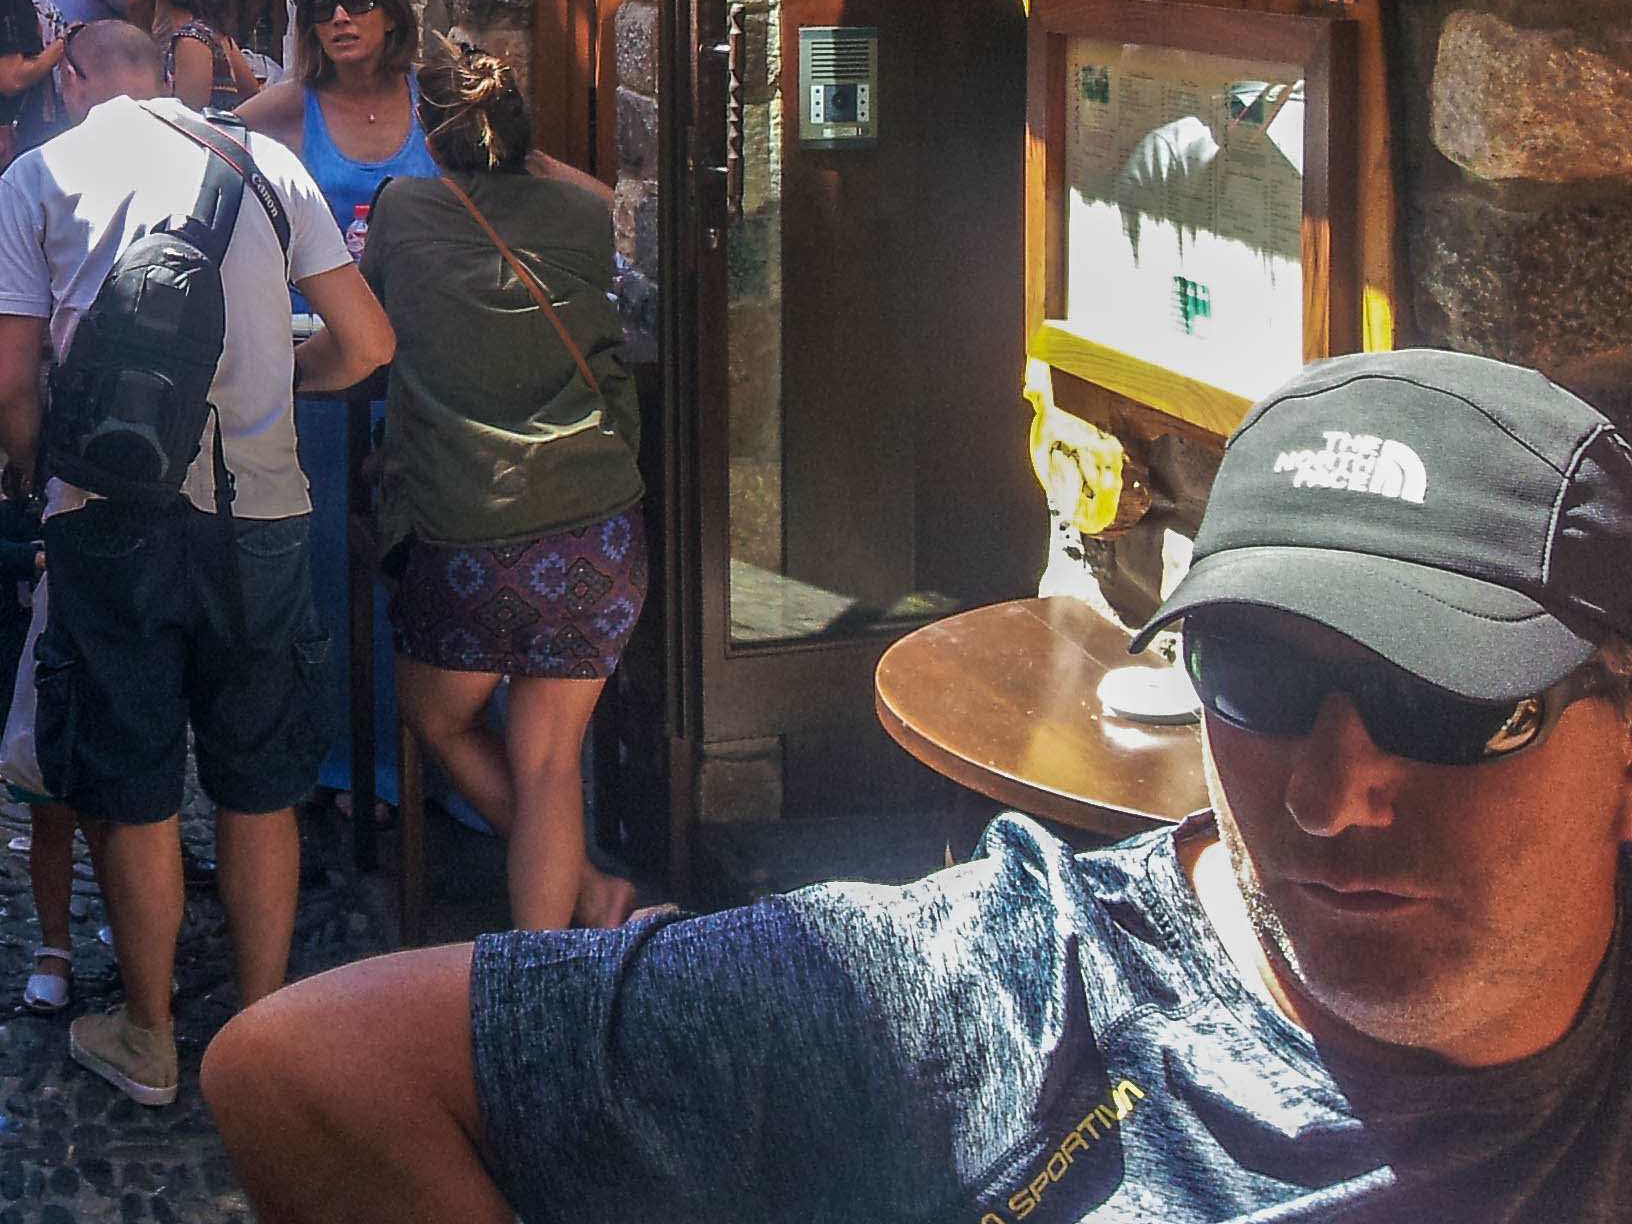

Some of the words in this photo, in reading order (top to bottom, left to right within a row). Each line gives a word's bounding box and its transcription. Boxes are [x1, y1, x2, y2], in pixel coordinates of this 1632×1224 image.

[251, 172, 279, 217] Canon
[1322, 431, 1383, 456] THE
[1273, 449, 1378, 475] NORTH
[1292, 469, 1372, 493] FACE
